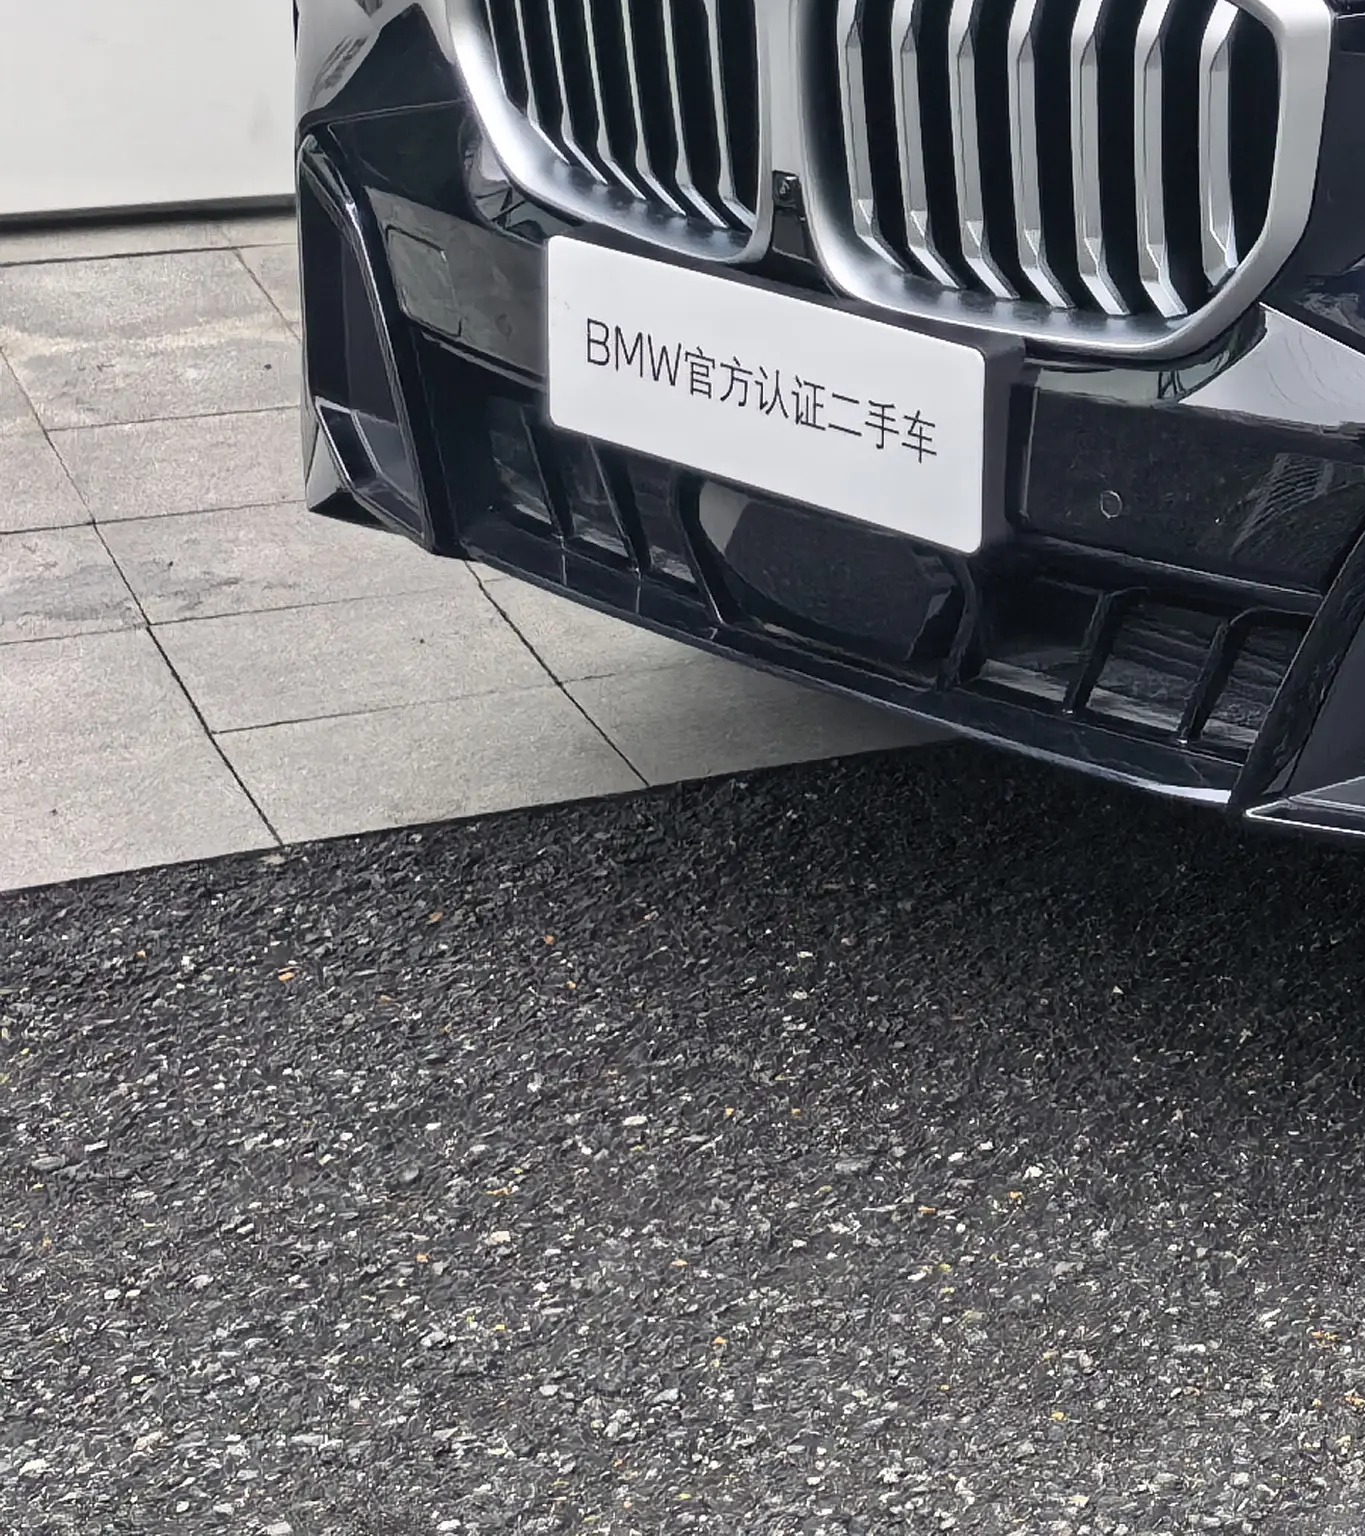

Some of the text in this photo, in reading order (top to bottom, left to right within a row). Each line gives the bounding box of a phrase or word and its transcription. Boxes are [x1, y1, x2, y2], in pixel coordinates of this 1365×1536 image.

[586, 318, 938, 464] BMW官方认证二手车
